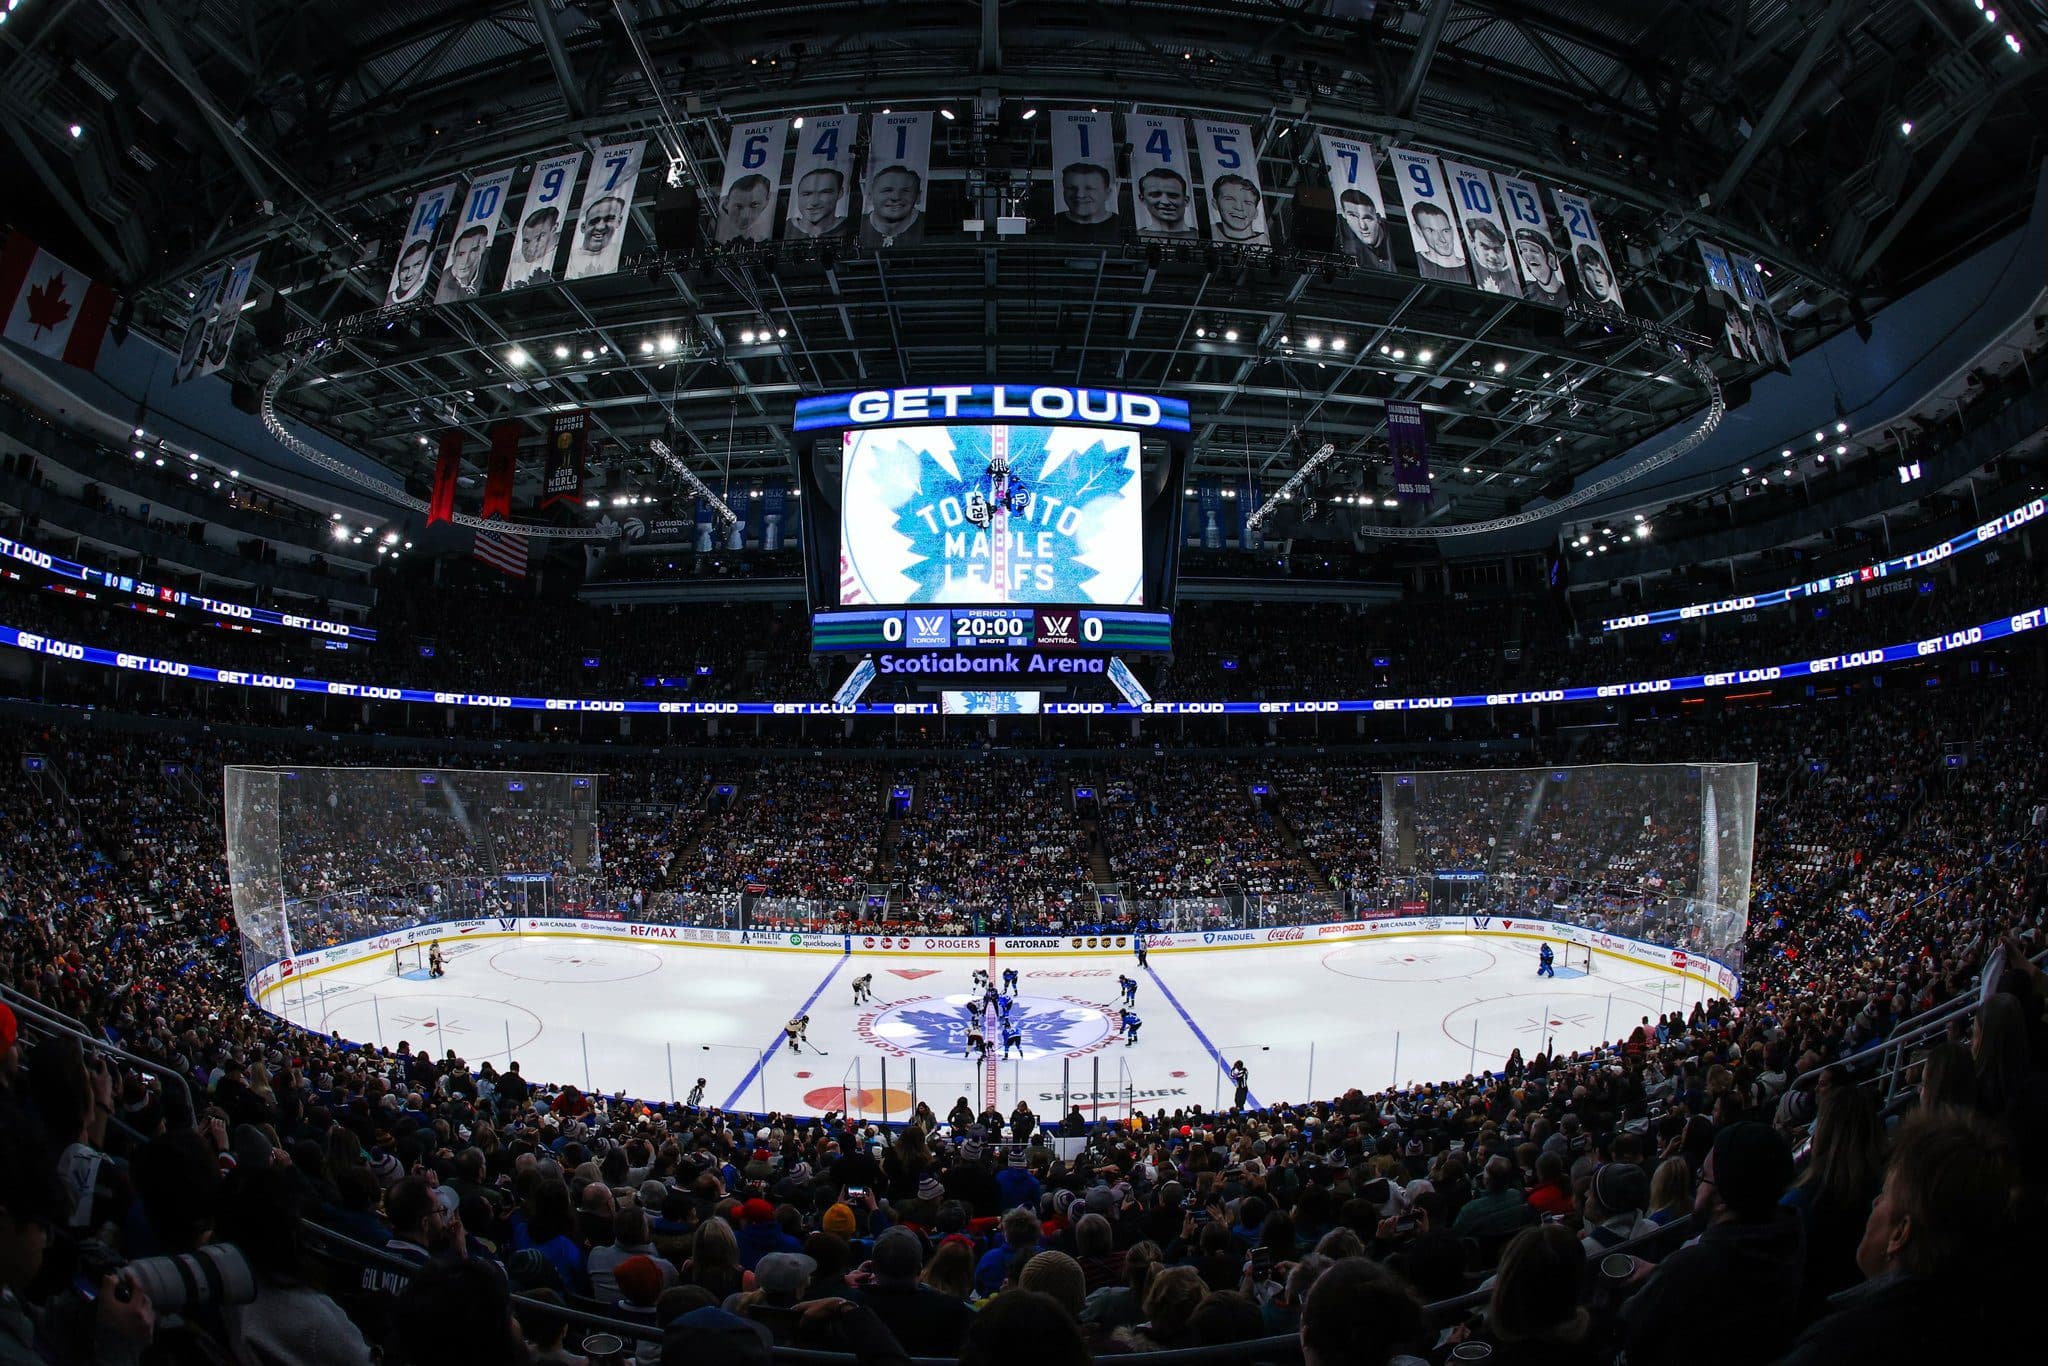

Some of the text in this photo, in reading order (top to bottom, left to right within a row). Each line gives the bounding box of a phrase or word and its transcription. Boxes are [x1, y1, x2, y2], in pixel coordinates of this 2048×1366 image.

[887, 117, 917, 126] BOWER
[745, 126, 774, 136] BAILEY
[812, 128, 839, 161] 4
[896, 126, 906, 159] 1
[1078, 124, 1089, 158] 1
[1146, 129, 1172, 162] 4
[1331, 141, 1361, 151] HORTON
[604, 148, 633, 159] CLANCY
[742, 135, 769, 169] 6
[1213, 135, 1240, 169] 5
[1398, 153, 1430, 165] KENNEDY
[540, 158, 576, 171] CONACHER
[1337, 150, 1358, 184] 7
[604, 157, 628, 191] 7
[1408, 164, 1434, 198] 9
[539, 168, 565, 203] 9
[466, 186, 500, 222] 10
[1456, 176, 1492, 214] 10
[1506, 187, 1540, 225] 13
[411, 198, 443, 236] 14
[1563, 203, 1597, 241] 21
[849, 387, 1162, 426] GET LOUD
[554, 421, 584, 431] RAPTORS
[555, 414, 584, 425] TORONTO
[548, 475, 577, 488] WORLD
[1977, 499, 2045, 541] GET LOUD
[13, 544, 52, 569] LOUD
[1920, 542, 1952, 566] LOUD
[212, 601, 252, 618] LOUD
[1680, 596, 1756, 619] GET LOUD
[282, 614, 349, 636] GET LOUD
[883, 618, 902, 641] 0
[956, 618, 1024, 637] 20:00
[1083, 618, 1103, 641] 0
[1610, 614, 1650, 630] LOUD
[2010, 609, 2041, 632] GET
[17, 631, 84, 660] GET LOUD
[1917, 627, 1982, 655] GET LOUD
[117, 653, 189, 677] GET LOUD
[880, 653, 1103, 673] Scotiabank Arena
[1809, 650, 1884, 674] GET LOUD
[217, 670, 295, 690] GET LOUD
[1703, 666, 1781, 687] GET LOUD
[328, 682, 401, 699] GET LOUD
[1597, 679, 1671, 697] GET LOUD
[434, 692, 511, 707] GET LOUD
[545, 699, 625, 711] GET LOUD
[1373, 697, 1453, 710] GET LOUD
[1486, 690, 1564, 705] GET LOUD
[659, 702, 738, 713] GET LOUD
[773, 703, 806, 714] GET
[894, 703, 928, 714] GET
[1057, 703, 1104, 714] LOUD
[1141, 703, 1224, 713] GET LOUD
[1259, 701, 1339, 713] GET LOUD
[416, 927, 443, 938] HYUNDAI
[631, 926, 677, 939] RE/MAX
[1318, 923, 1365, 937] pizza pizza
[1389, 920, 1417, 928] CANADA
[803, 939, 841, 948] quickbooks
[938, 940, 980, 949] ROGERS
[1005, 940, 1060, 948] GATORADE
[1147, 934, 1174, 948] Barbie
[1217, 933, 1256, 942] FANDUEL
